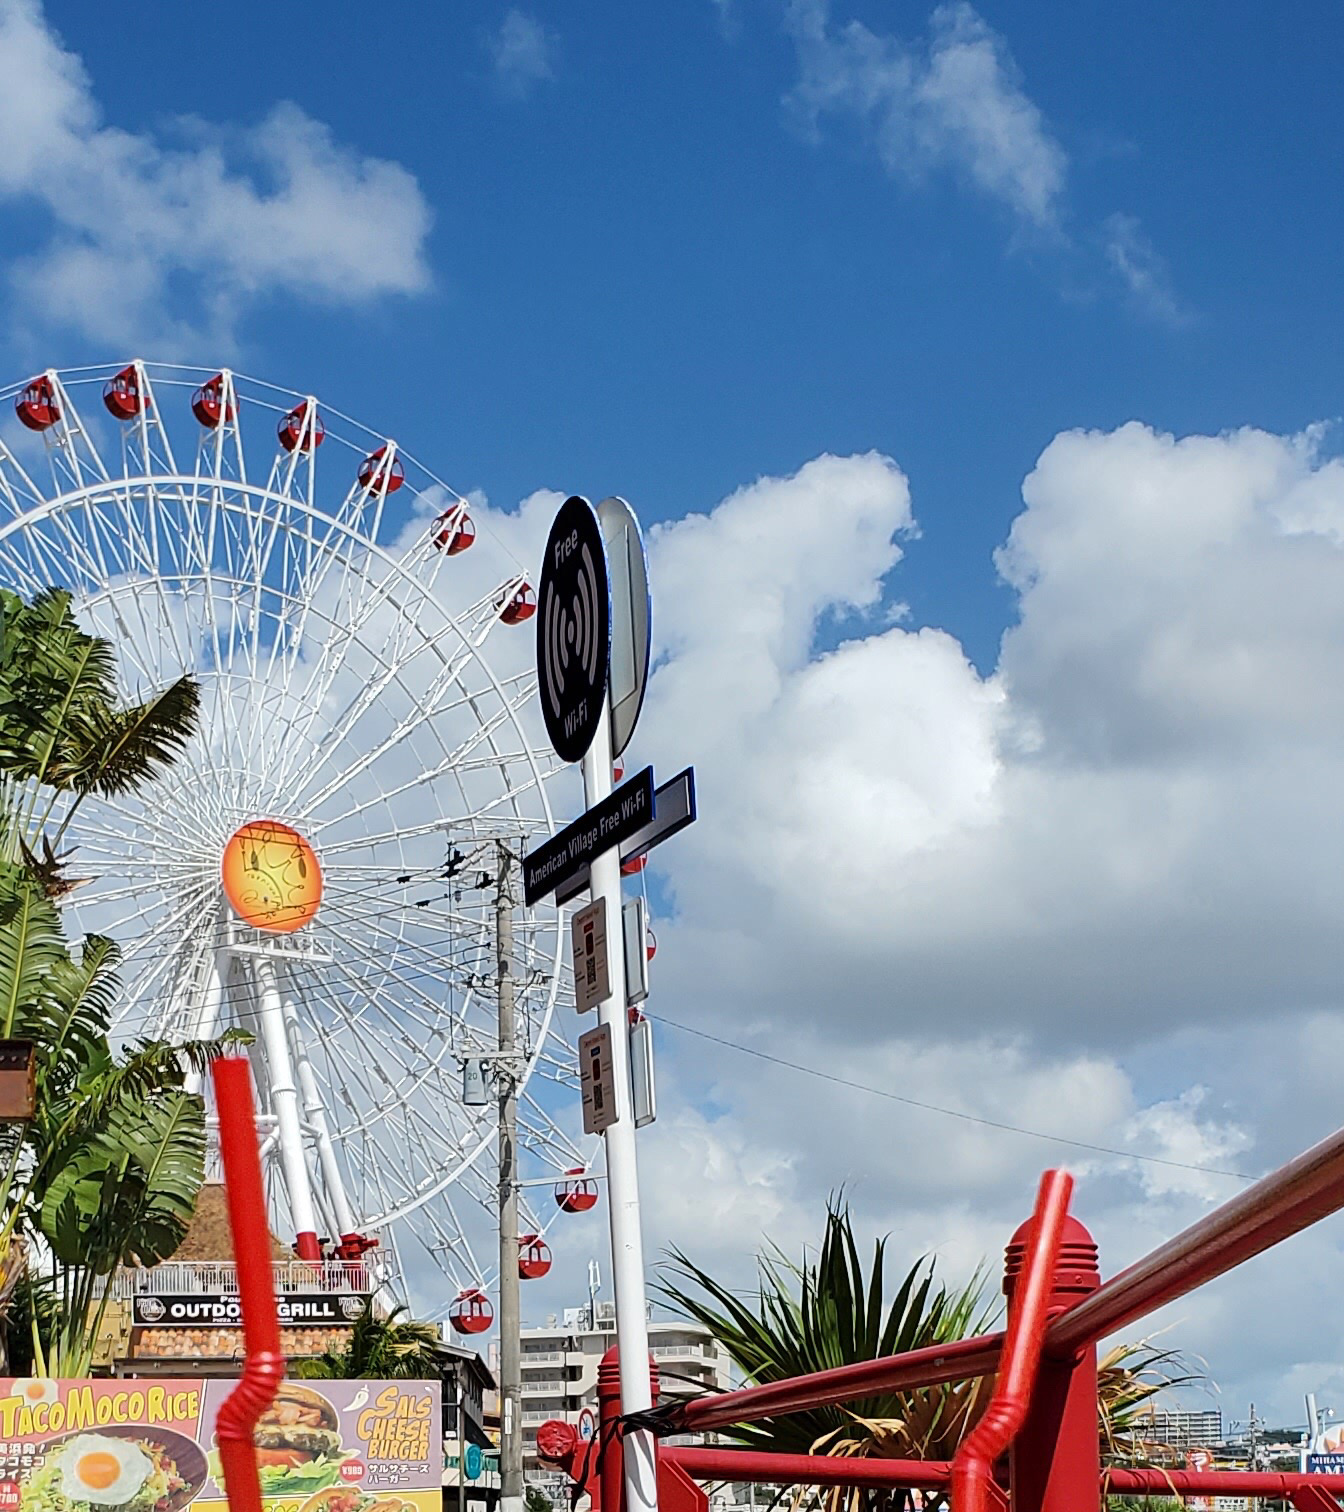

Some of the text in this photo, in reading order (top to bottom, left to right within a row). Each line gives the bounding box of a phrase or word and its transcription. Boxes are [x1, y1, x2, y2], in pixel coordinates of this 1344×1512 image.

[554, 528, 578, 569] Free
[564, 709, 588, 739] Wi-Fi
[529, 787, 645, 888] American Village Free Wi-Fi
[467, 1072, 478, 1081] 20
[276, 1303, 335, 1316] GRILL
[66, 1386, 144, 1430] MOCO
[147, 1386, 199, 1424] RICE
[375, 1385, 433, 1418] SALS
[357, 1408, 432, 1441] CHEESE
[367, 1439, 430, 1461] BURGER
[1311, 1455, 1344, 1464] MIHAM
[368, 1463, 429, 1474] サルサチーズ
